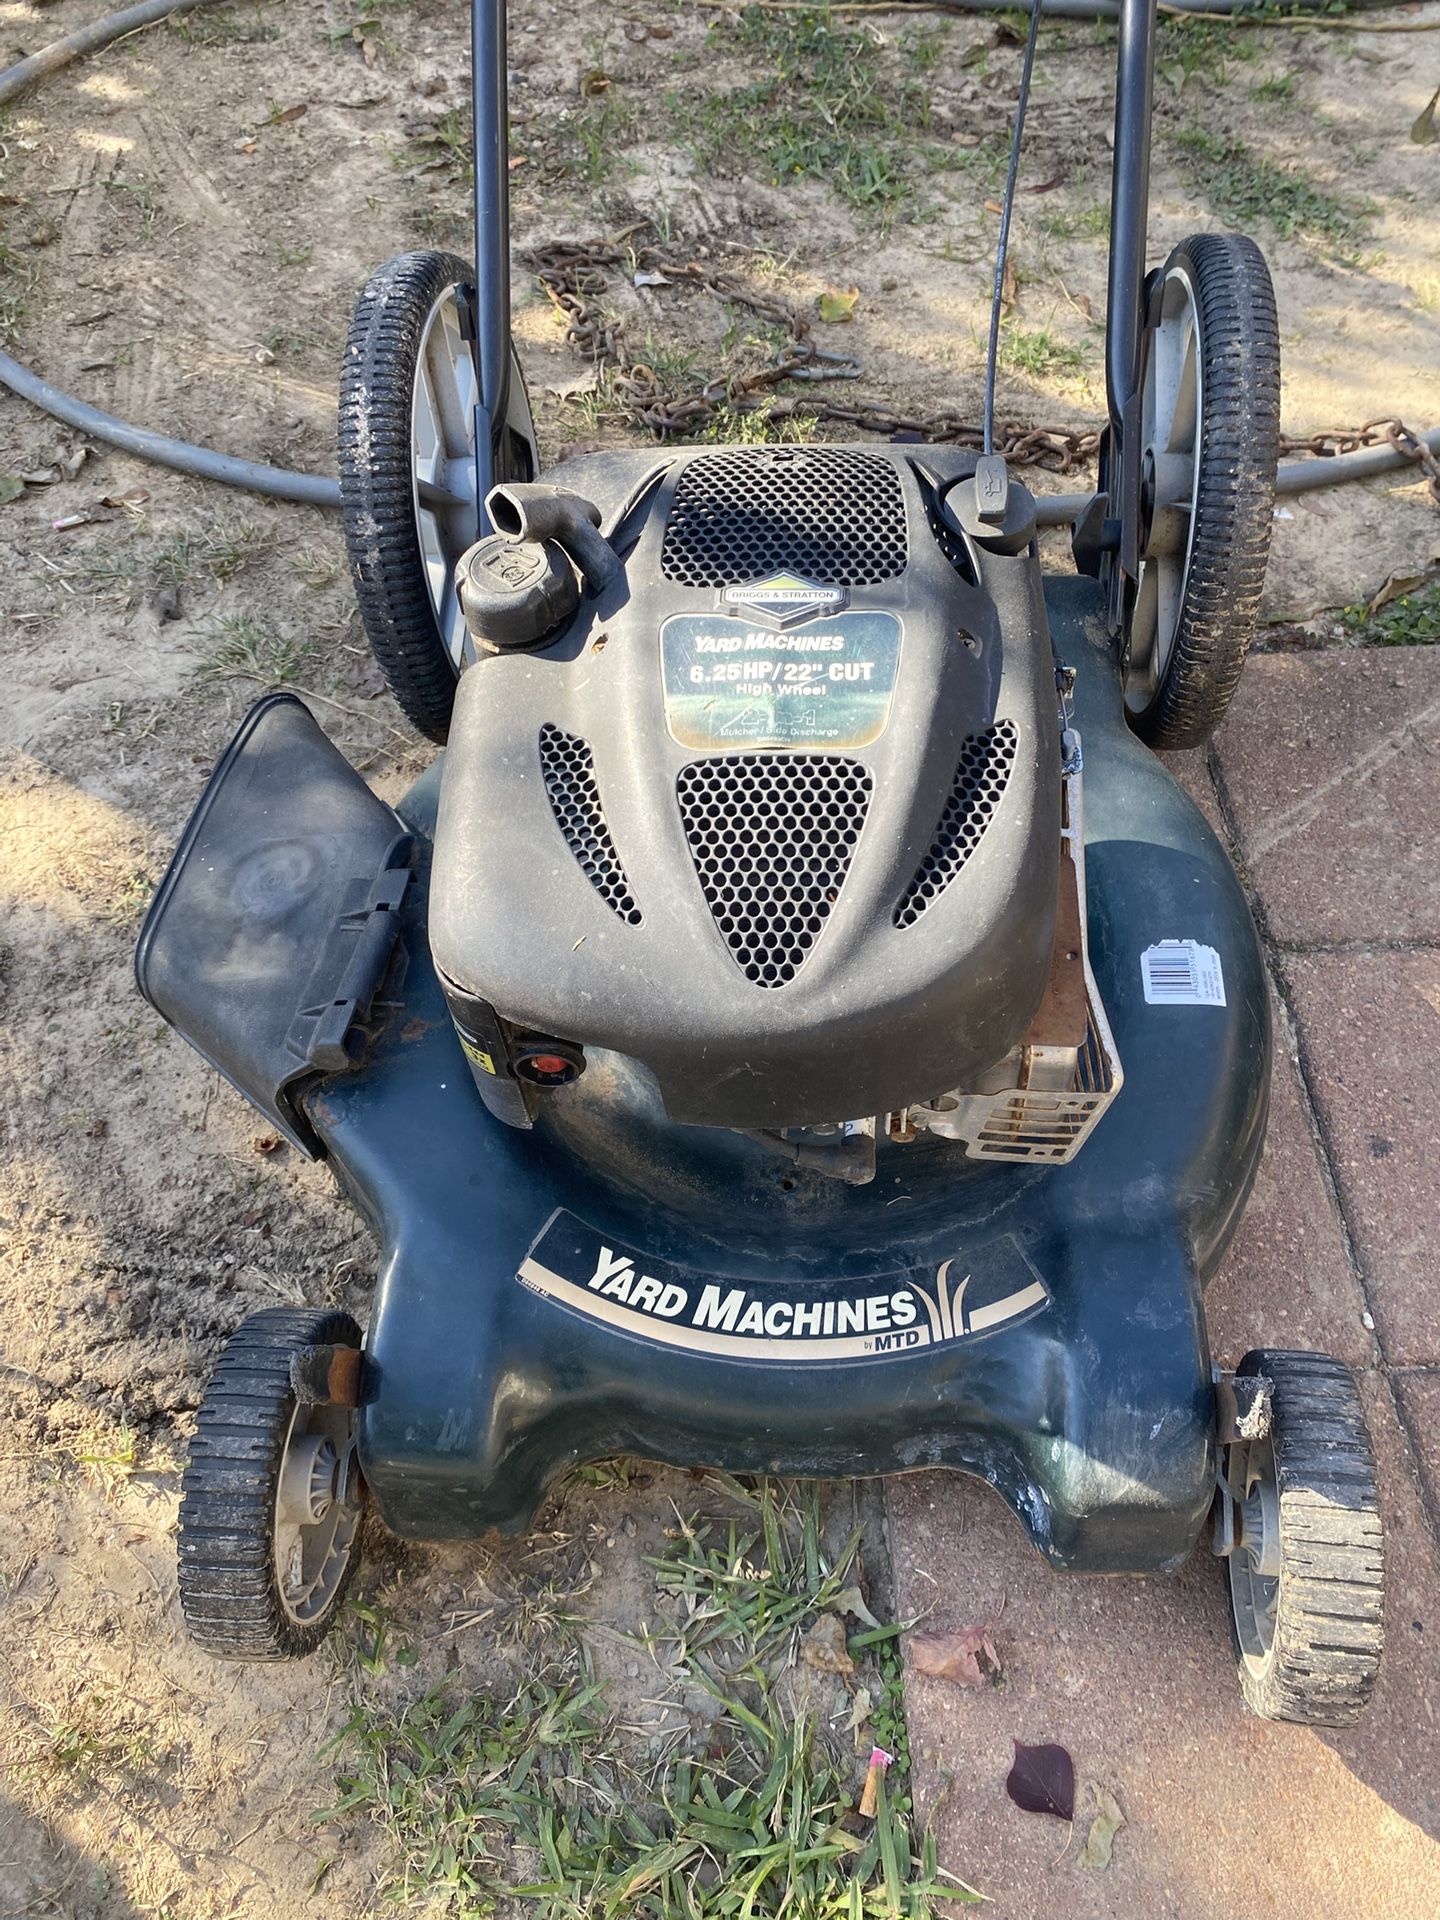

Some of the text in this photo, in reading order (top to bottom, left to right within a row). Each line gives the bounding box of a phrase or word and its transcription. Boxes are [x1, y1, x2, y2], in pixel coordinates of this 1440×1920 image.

[732, 591, 834, 599] BRIGGS & STRATTON
[694, 632, 845, 653] YARD MACHINES
[828, 662, 875, 681] CUT
[735, 682, 826, 696] High Wheel
[790, 727, 839, 737] Discharge
[587, 1246, 917, 1336] YARD MACHINES
[864, 1330, 920, 1352] by MTD
